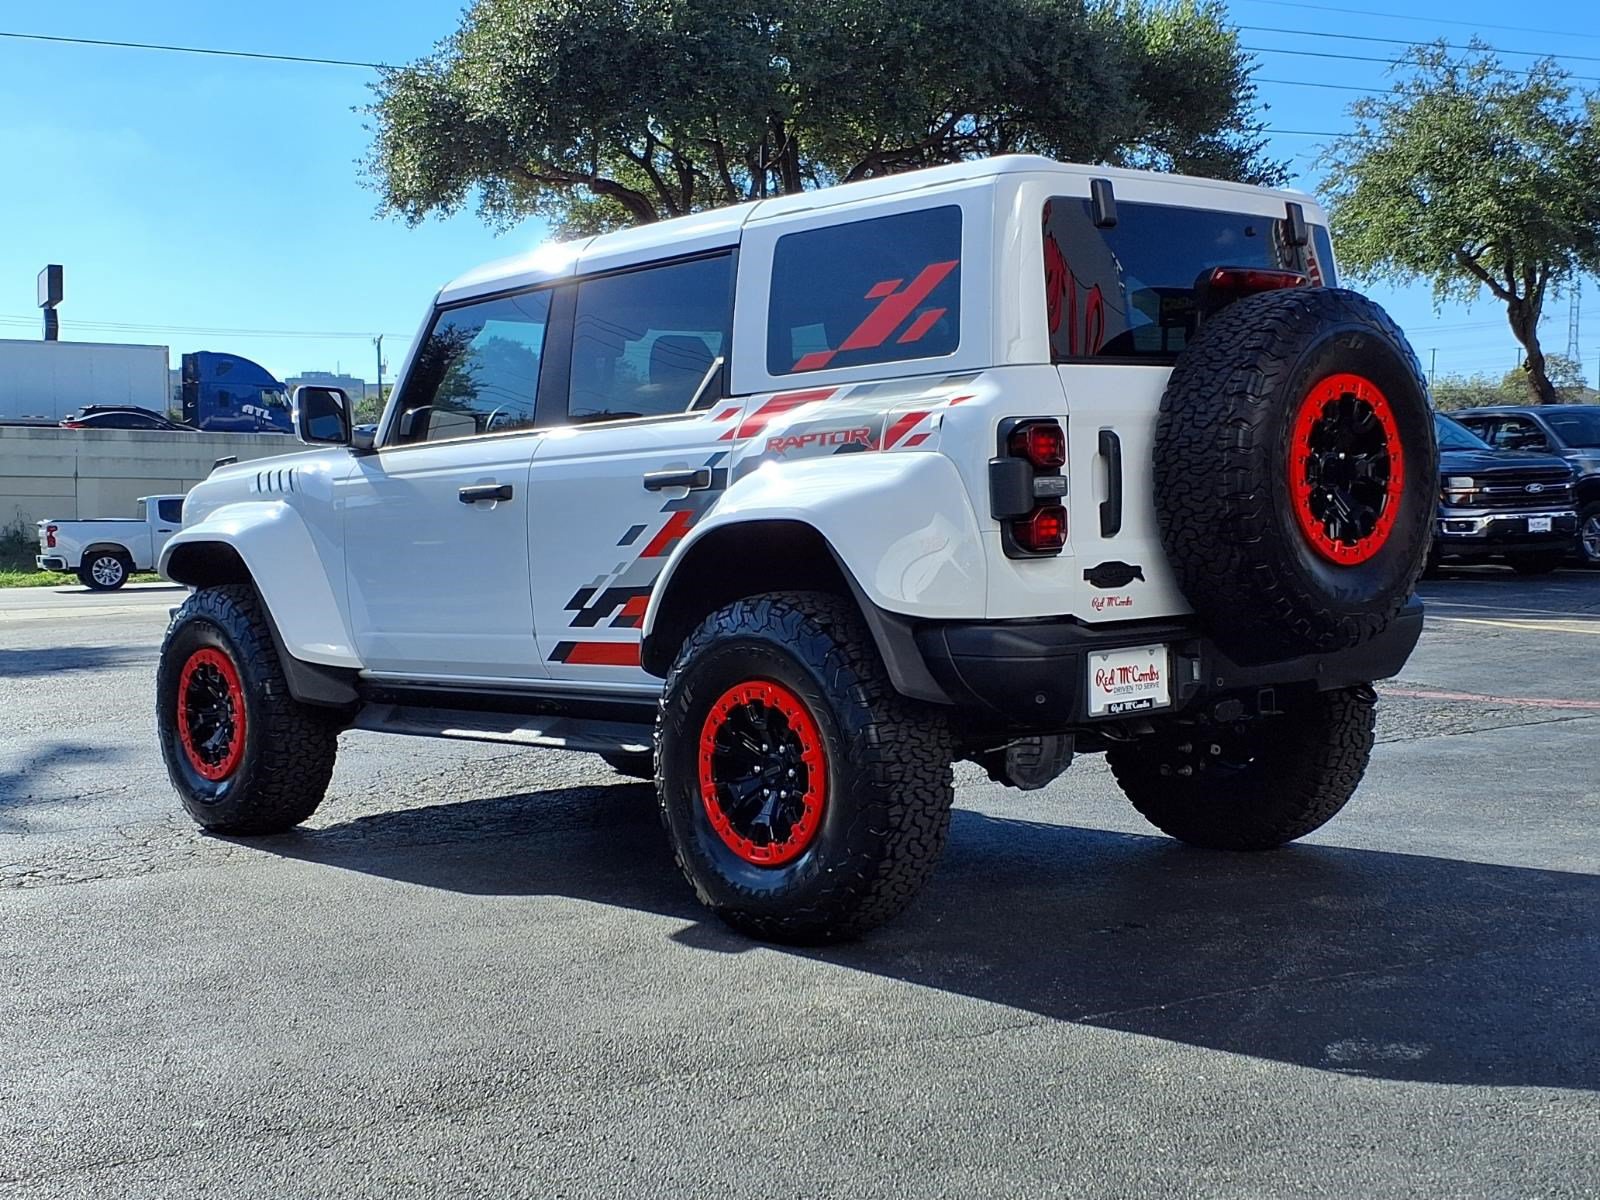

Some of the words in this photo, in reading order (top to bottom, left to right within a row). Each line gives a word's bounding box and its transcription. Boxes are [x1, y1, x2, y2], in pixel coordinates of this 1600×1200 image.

[242, 404, 273, 420] ATL
[766, 427, 874, 456] RAPTOR
[1091, 596, 1105, 611] Red
[1106, 596, 1132, 607] McCombs
[1095, 668, 1115, 693] Red
[1116, 664, 1159, 684] McCombs
[1113, 685, 1134, 694] DRIVEN
[1143, 682, 1160, 690] SERVE
